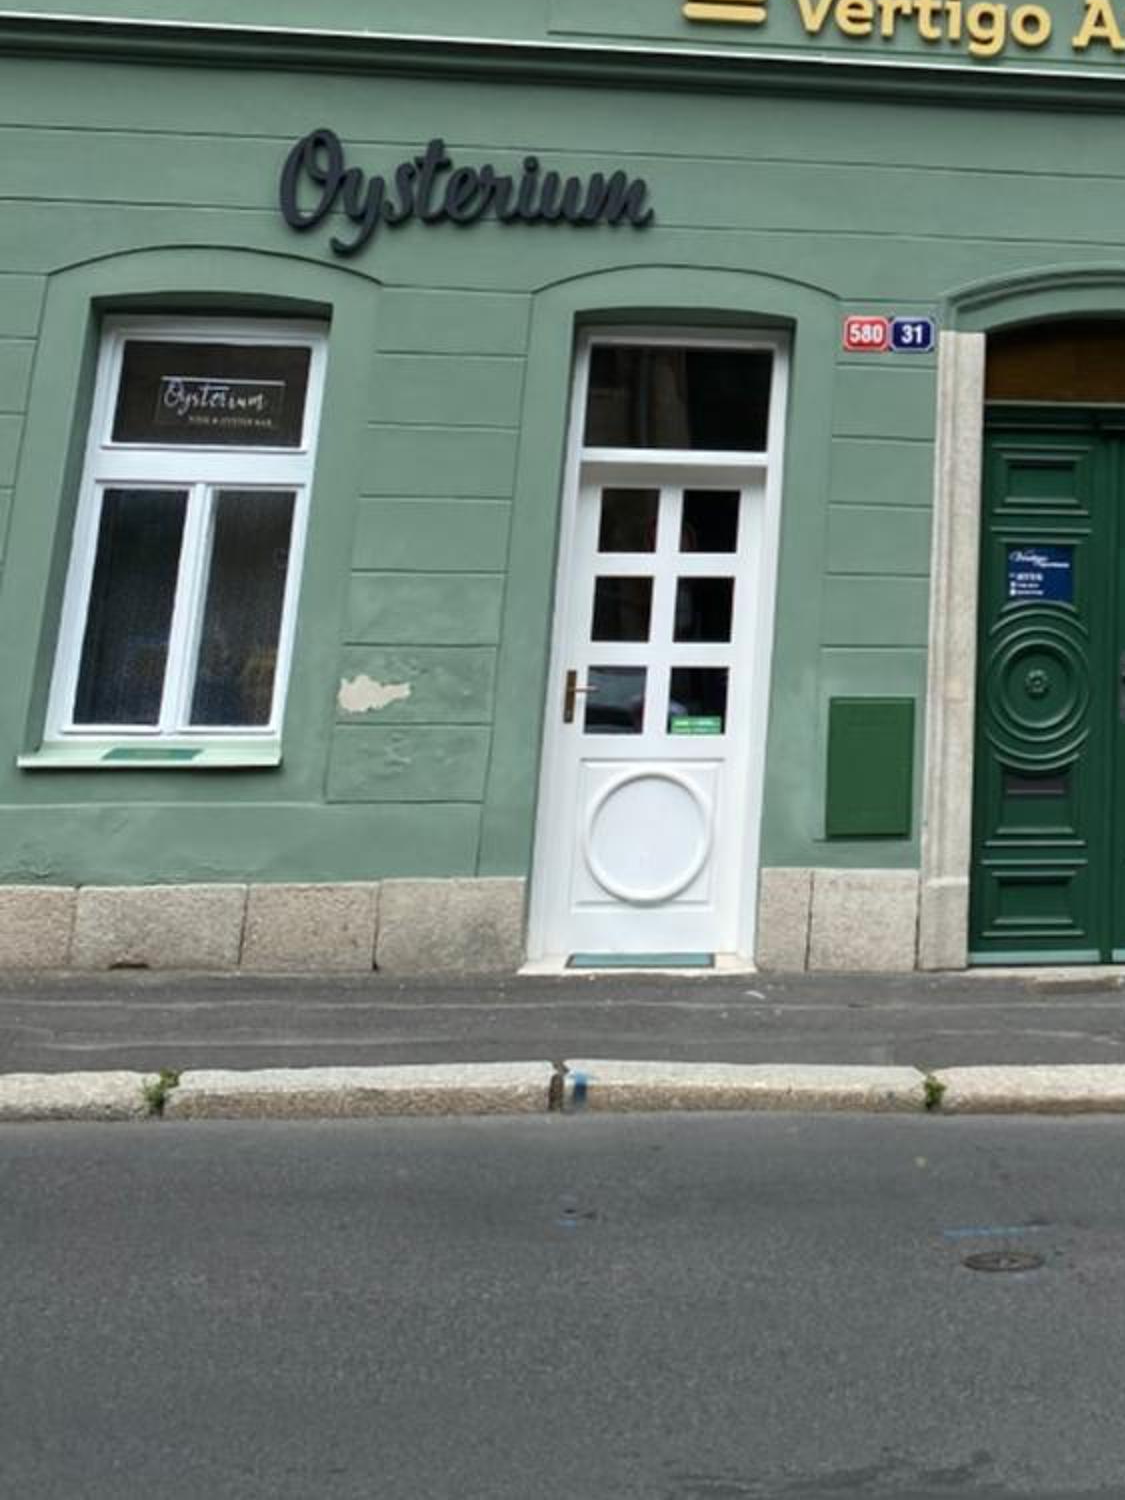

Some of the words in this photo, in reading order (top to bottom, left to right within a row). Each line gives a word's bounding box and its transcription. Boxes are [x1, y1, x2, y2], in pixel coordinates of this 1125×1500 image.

[280, 128, 654, 257] Oysterium
[849, 323, 884, 345] 580
[901, 323, 923, 345] 31
